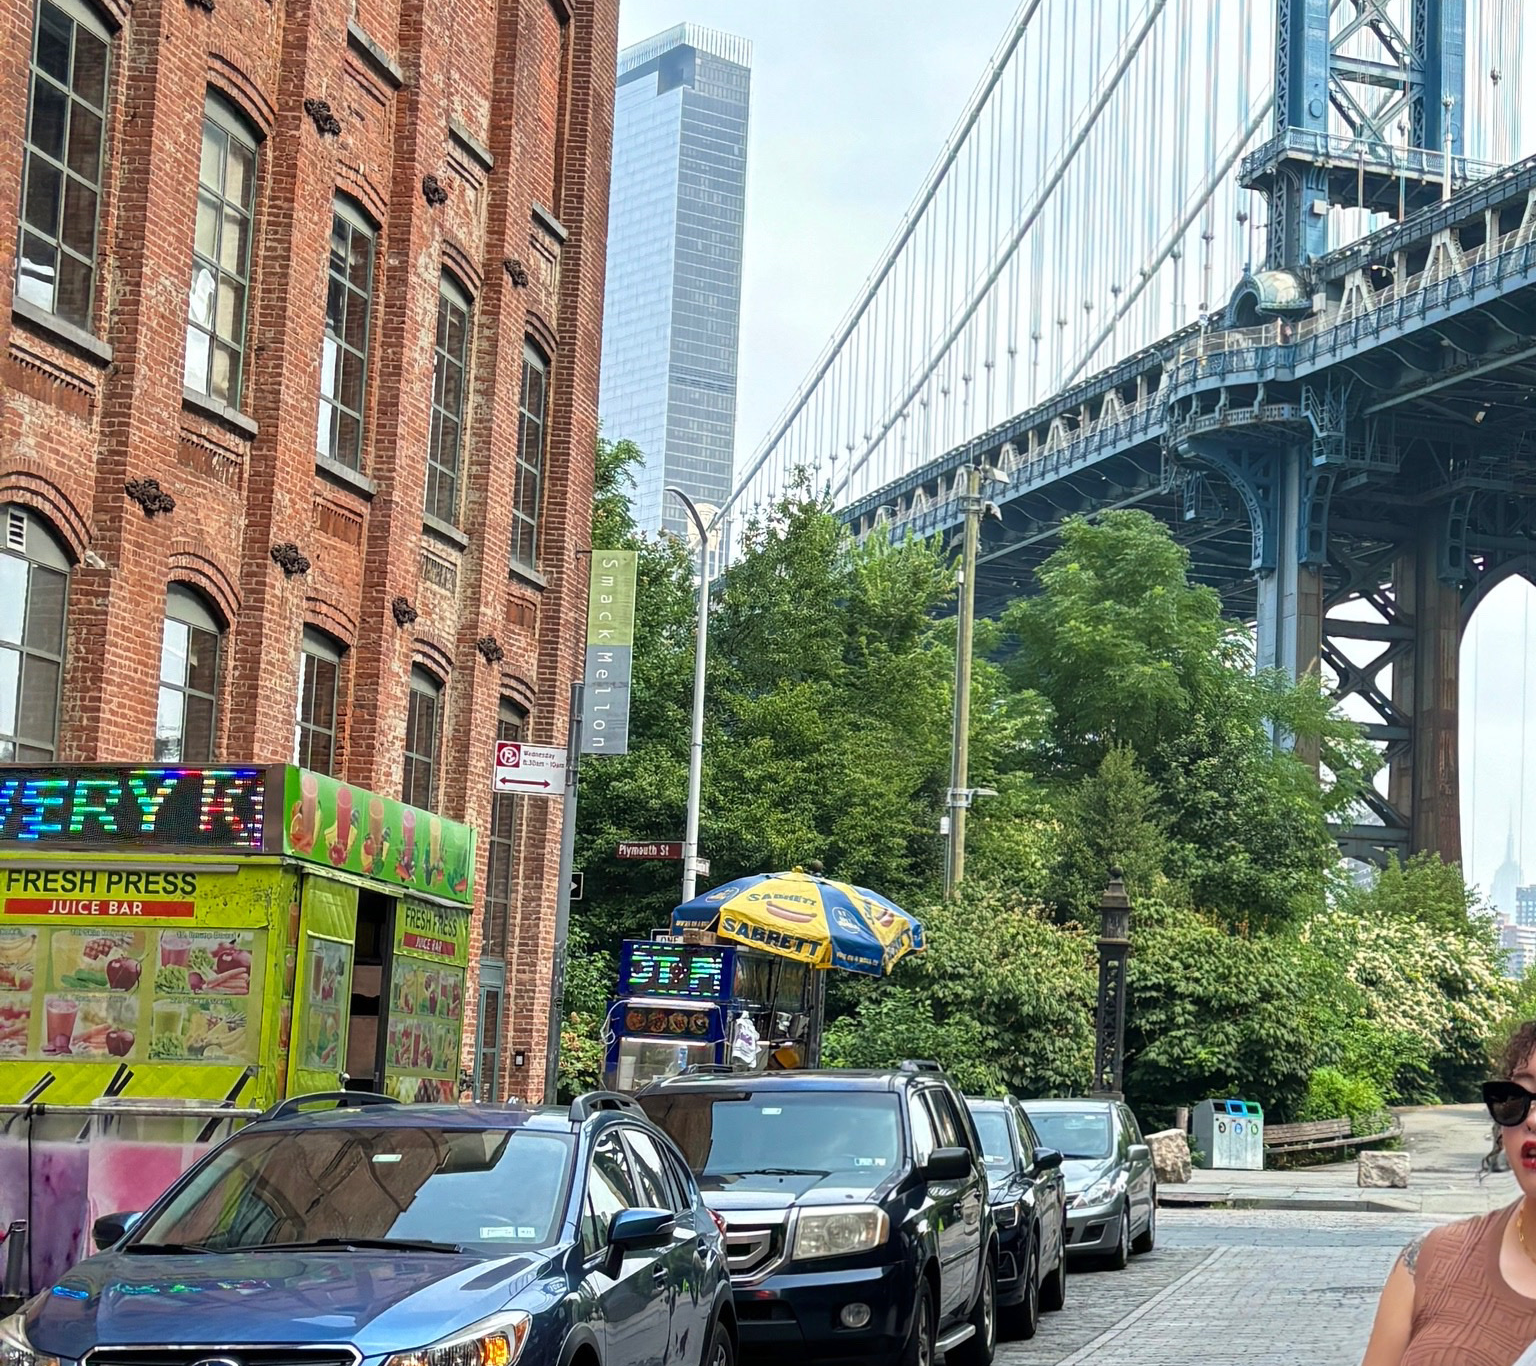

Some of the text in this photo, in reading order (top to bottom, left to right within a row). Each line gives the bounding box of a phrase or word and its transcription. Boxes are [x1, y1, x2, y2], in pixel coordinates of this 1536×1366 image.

[592, 559, 618, 747] Smack Mellon
[618, 844, 669, 858] Plymouth St
[6, 869, 197, 895] FRESH PRESS
[48, 900, 143, 915] JUICE BAR
[405, 906, 431, 932] FRESH
[722, 915, 823, 958] SABRETT
